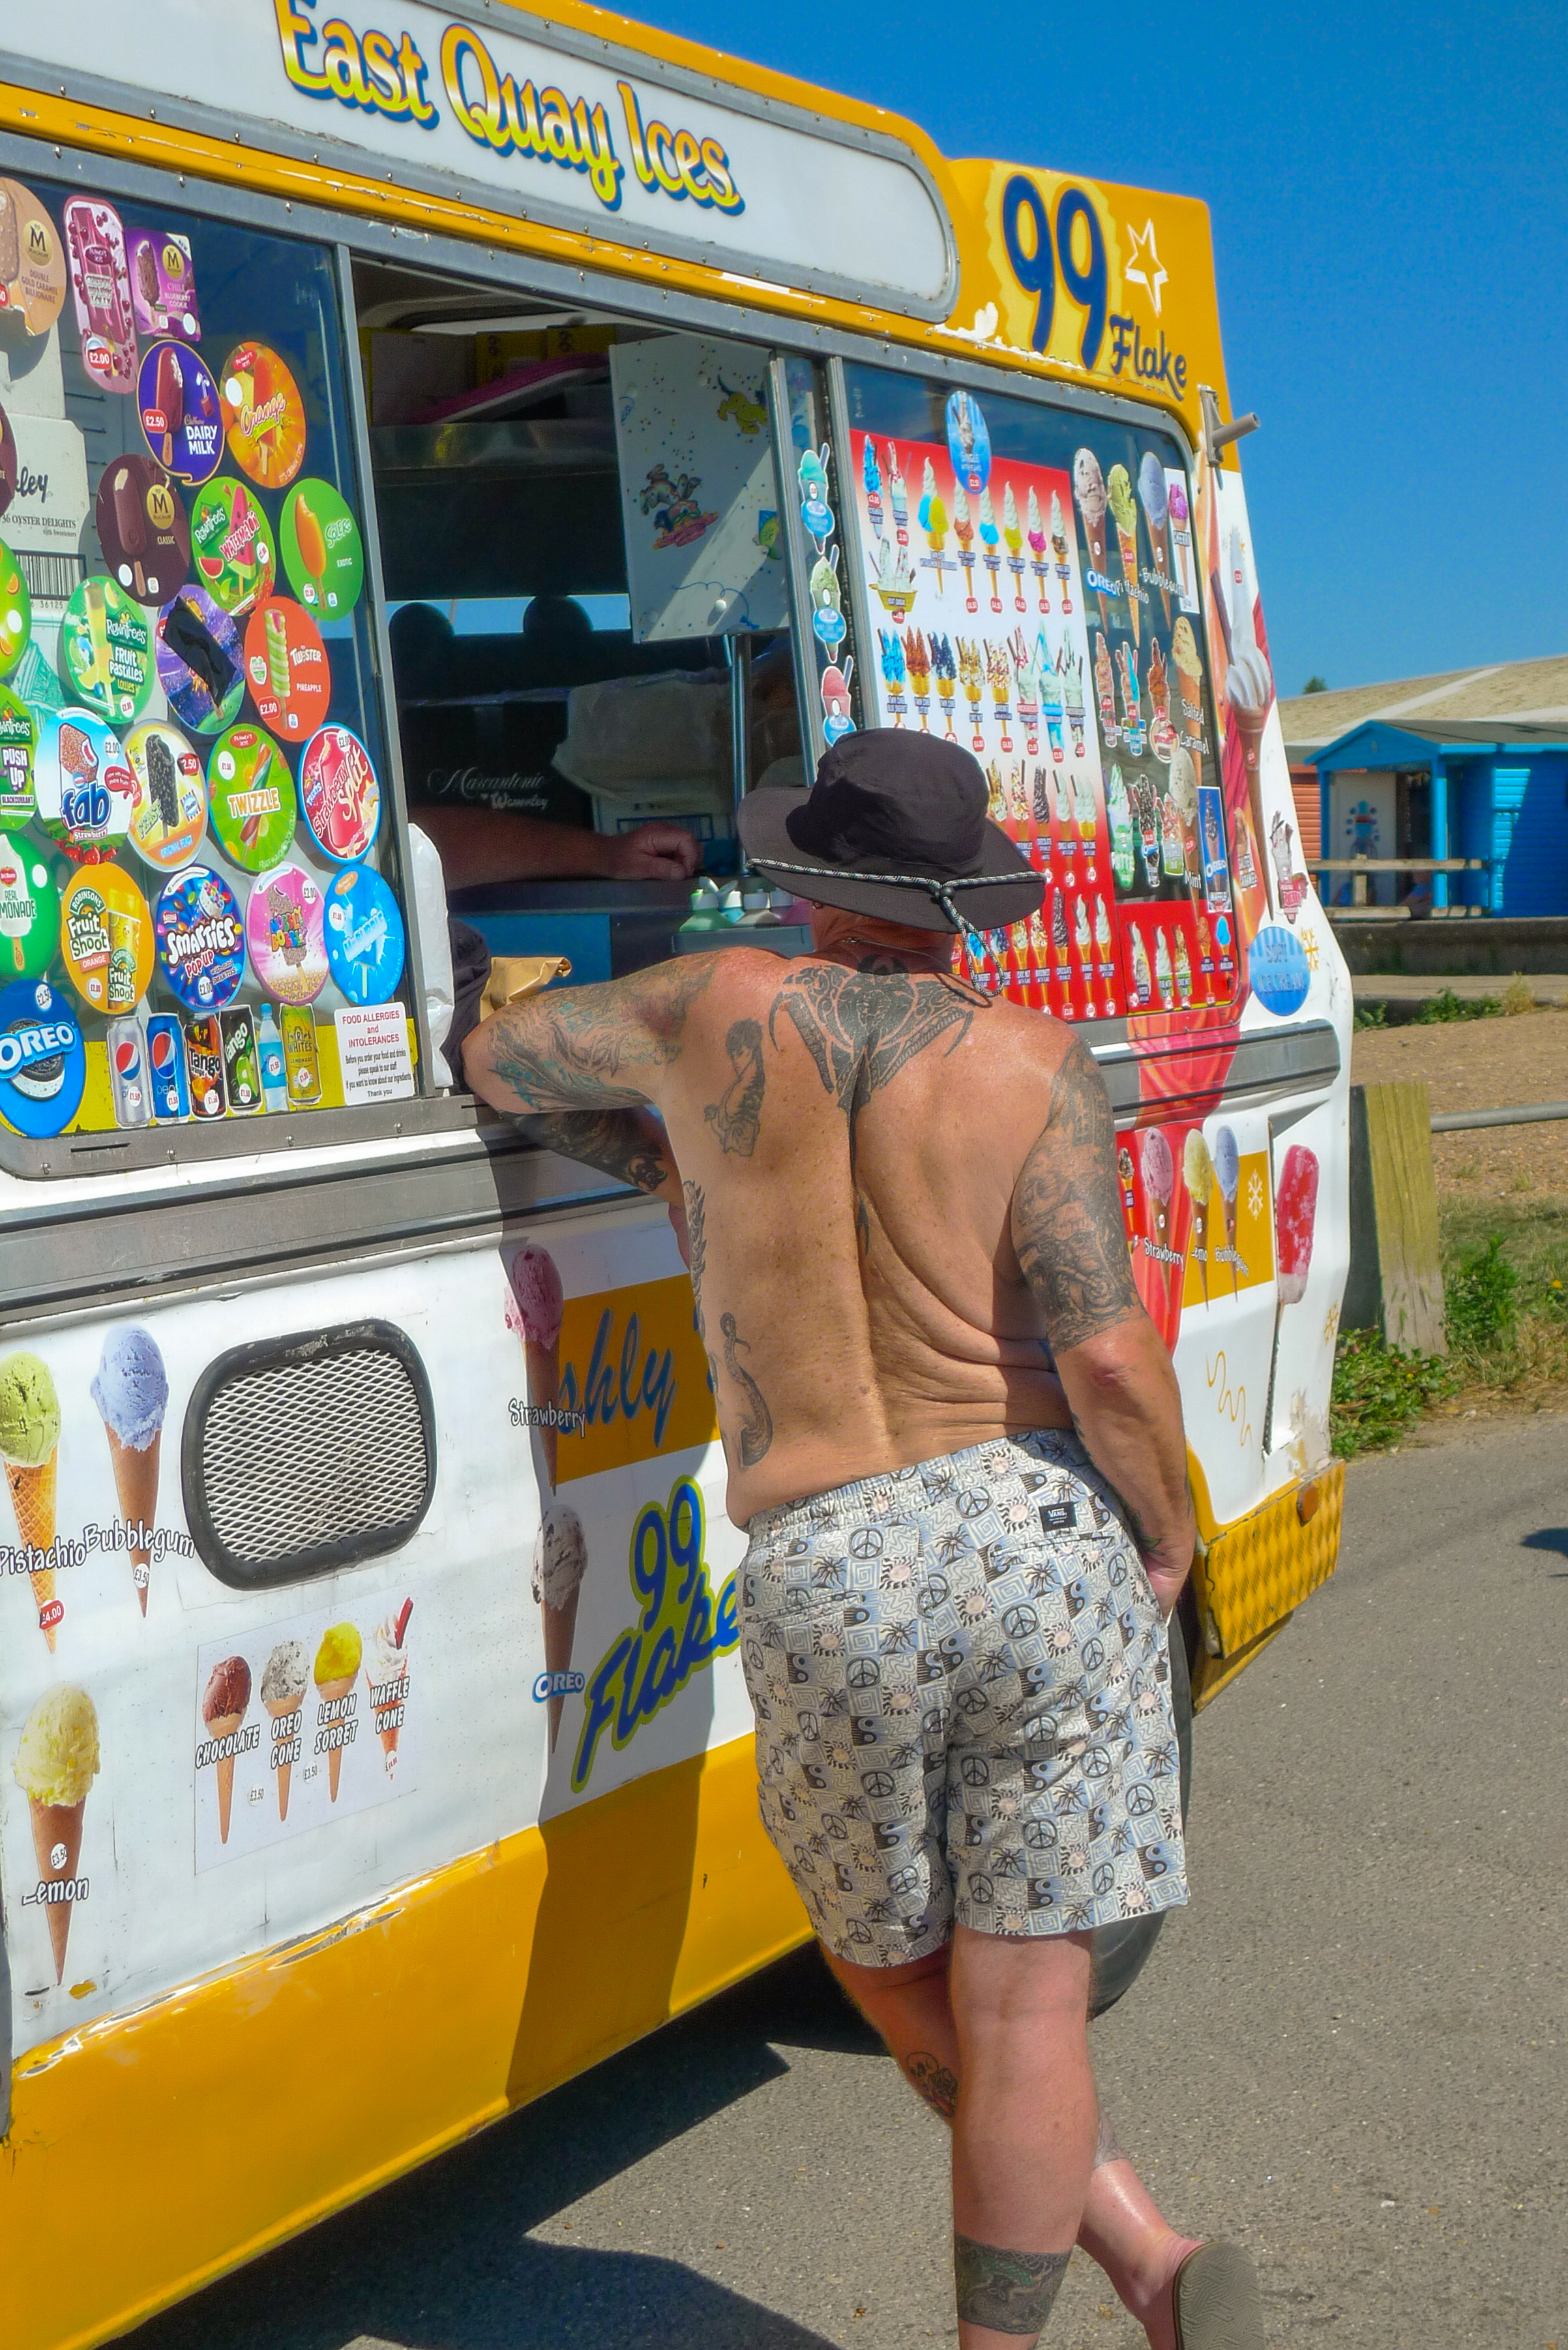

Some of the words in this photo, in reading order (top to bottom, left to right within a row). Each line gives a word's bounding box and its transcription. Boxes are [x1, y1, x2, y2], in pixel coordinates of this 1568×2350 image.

[274, 0, 439, 130] East
[440, 23, 625, 211] Quay
[617, 80, 745, 216] Ices
[30, 226, 46, 252] M
[177, 238, 188, 252] NEW
[167, 253, 180, 269] M
[30, 269, 50, 282] DOUBLE
[1000, 172, 1109, 372] 99
[22, 276, 35, 288] GOLD
[36, 280, 59, 296] CARAMEL
[25, 286, 55, 304] BILLIONAIRE
[164, 292, 190, 302] BLUEBERRY
[170, 300, 188, 309] COOKIE
[89, 352, 110, 364] £2.00
[1109, 314, 1188, 402] Flake
[145, 415, 164, 427] £2.50
[241, 393, 286, 436] Orange
[186, 425, 218, 441] DAIRY
[189, 440, 215, 455] MILK
[16, 466, 49, 503] ley
[151, 492, 169, 514] M
[12, 515, 40, 526] OYSTER
[42, 516, 76, 529] DELIGHTS
[194, 507, 226, 544] Rowntree's
[157, 535, 175, 545] CLASSIC
[219, 509, 261, 563] WATERMELON
[336, 558, 353, 568] EXOTIC
[1087, 569, 1117, 597] OREO
[1141, 567, 1185, 599] Bubblegum
[106, 618, 147, 645] Rowntree's
[290, 646, 322, 666] TWISTER
[297, 683, 322, 692] PINEAPPLE
[260, 703, 277, 715] £2.00
[1182, 698, 1205, 726] Salted
[0, 718, 31, 737] wntree's
[1180, 730, 1209, 755] Caramel
[1, 748, 28, 767] PUSH
[182, 758, 196, 769] 2.50
[10, 767, 25, 789] UP
[338, 745, 368, 822] Split
[62, 781, 112, 830] fab
[228, 787, 281, 819] TWIZZLE
[74, 829, 108, 840] Strawberry
[1206, 859, 1227, 878] OREO
[1185, 869, 1202, 889] Mint
[5, 890, 18, 901] REAL
[71, 889, 102, 910] ROBINSONS
[0, 900, 36, 919] MONADE
[270, 904, 304, 933] NOBBLY
[68, 913, 100, 938] Fruit
[70, 932, 110, 958] Shoot
[167, 917, 235, 964] SMARTIES
[271, 927, 308, 952] BOBBLY
[82, 955, 106, 968] ORANGE
[185, 958, 203, 977] POP
[202, 949, 214, 966] UP
[109, 967, 132, 985] Fruit
[1258, 972, 1273, 994] ICE
[1273, 972, 1305, 994] CREAM
[37, 983, 52, 1005] £2.50
[108, 985, 135, 1001] Shoot
[342, 1015, 361, 1024] FOOD
[363, 1010, 400, 1022] ALLERGIES
[367, 1024, 379, 1034] and
[0, 1024, 74, 1071] OREO
[288, 1042, 312, 1054] WHITES
[348, 1034, 400, 1048] INTOLERANCES
[189, 1046, 220, 1077] Tango
[270, 1061, 280, 1071] £1.50
[346, 1054, 357, 1064] Before
[396, 1048, 406, 1057] drinks
[300, 1071, 310, 1082] £1.50
[358, 1067, 369, 1076] please
[369, 1065, 379, 1075] speak
[368, 1077, 377, 1086] know
[378, 1075, 387, 1084] about
[394, 1073, 411, 1084] ingredients
[129, 1092, 141, 1101] £1.50
[156, 1084, 182, 1097] pepi
[241, 1088, 251, 1098] £1.50
[367, 1089, 383, 1097] Thank
[383, 1088, 392, 1097] you
[168, 1097, 179, 1106] £1.50
[1144, 1237, 1184, 1273] Strawberry
[1215, 1244, 1249, 1279] Bubblegum
[558, 1307, 679, 1450] shly
[508, 1397, 586, 1438] Strawberry
[1047, 1508, 1065, 1518] VANS
[83, 1519, 195, 1562] Bubblegum
[0, 1535, 87, 1577] Pistachio
[631, 1478, 705, 1632] 99
[134, 1569, 150, 1584] £3.50
[42, 1605, 62, 1625] £4.00
[532, 1671, 585, 1703] OREO
[574, 1570, 741, 1791] Flake
[369, 1675, 411, 1709] WAFFLE
[317, 1692, 357, 1726] LEMON
[375, 1704, 406, 1734] CONE
[271, 1710, 303, 1740] OREO
[195, 1723, 261, 1770] CHOCOLATE
[314, 1719, 359, 1755] SORBET
[270, 1737, 302, 1770] CONE
[303, 1764, 318, 1781] £3.50
[249, 1787, 264, 1802] £3.50
[52, 1847, 68, 1867] £3.50
